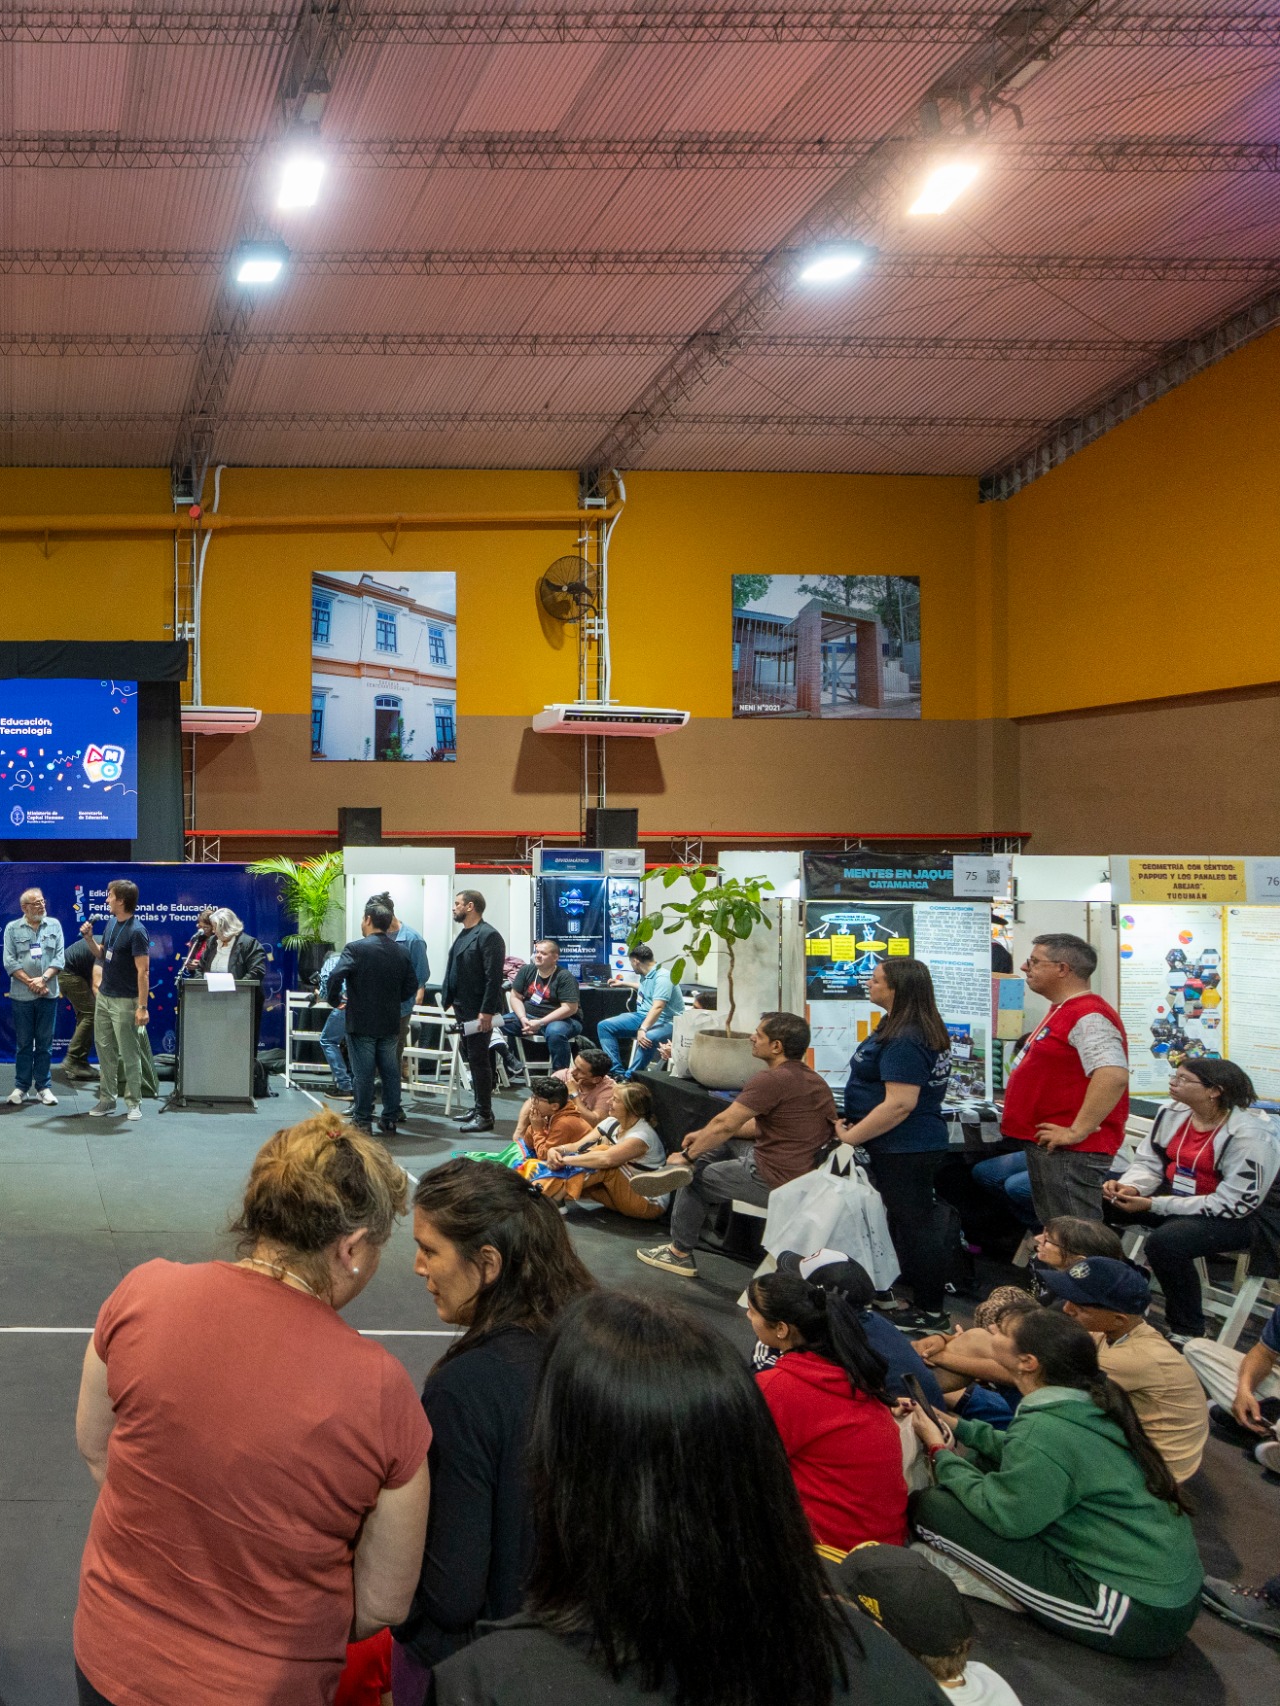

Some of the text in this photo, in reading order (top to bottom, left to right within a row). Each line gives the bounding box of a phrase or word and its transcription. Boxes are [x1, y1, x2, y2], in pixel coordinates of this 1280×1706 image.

[0, 717, 53, 727] Educación,
[0, 726, 52, 737] Tecnología
[843, 868, 954, 881] MENTES EN JAQUE
[965, 871, 978, 881] 75
[1138, 873, 1168, 881] PAPPUS
[1193, 873, 1226, 881] PANALES
[868, 880, 929, 889] CATAMARCA
[1266, 876, 1280, 887] 76
[157, 904, 169, 912] de
[160, 914, 166, 922] y
